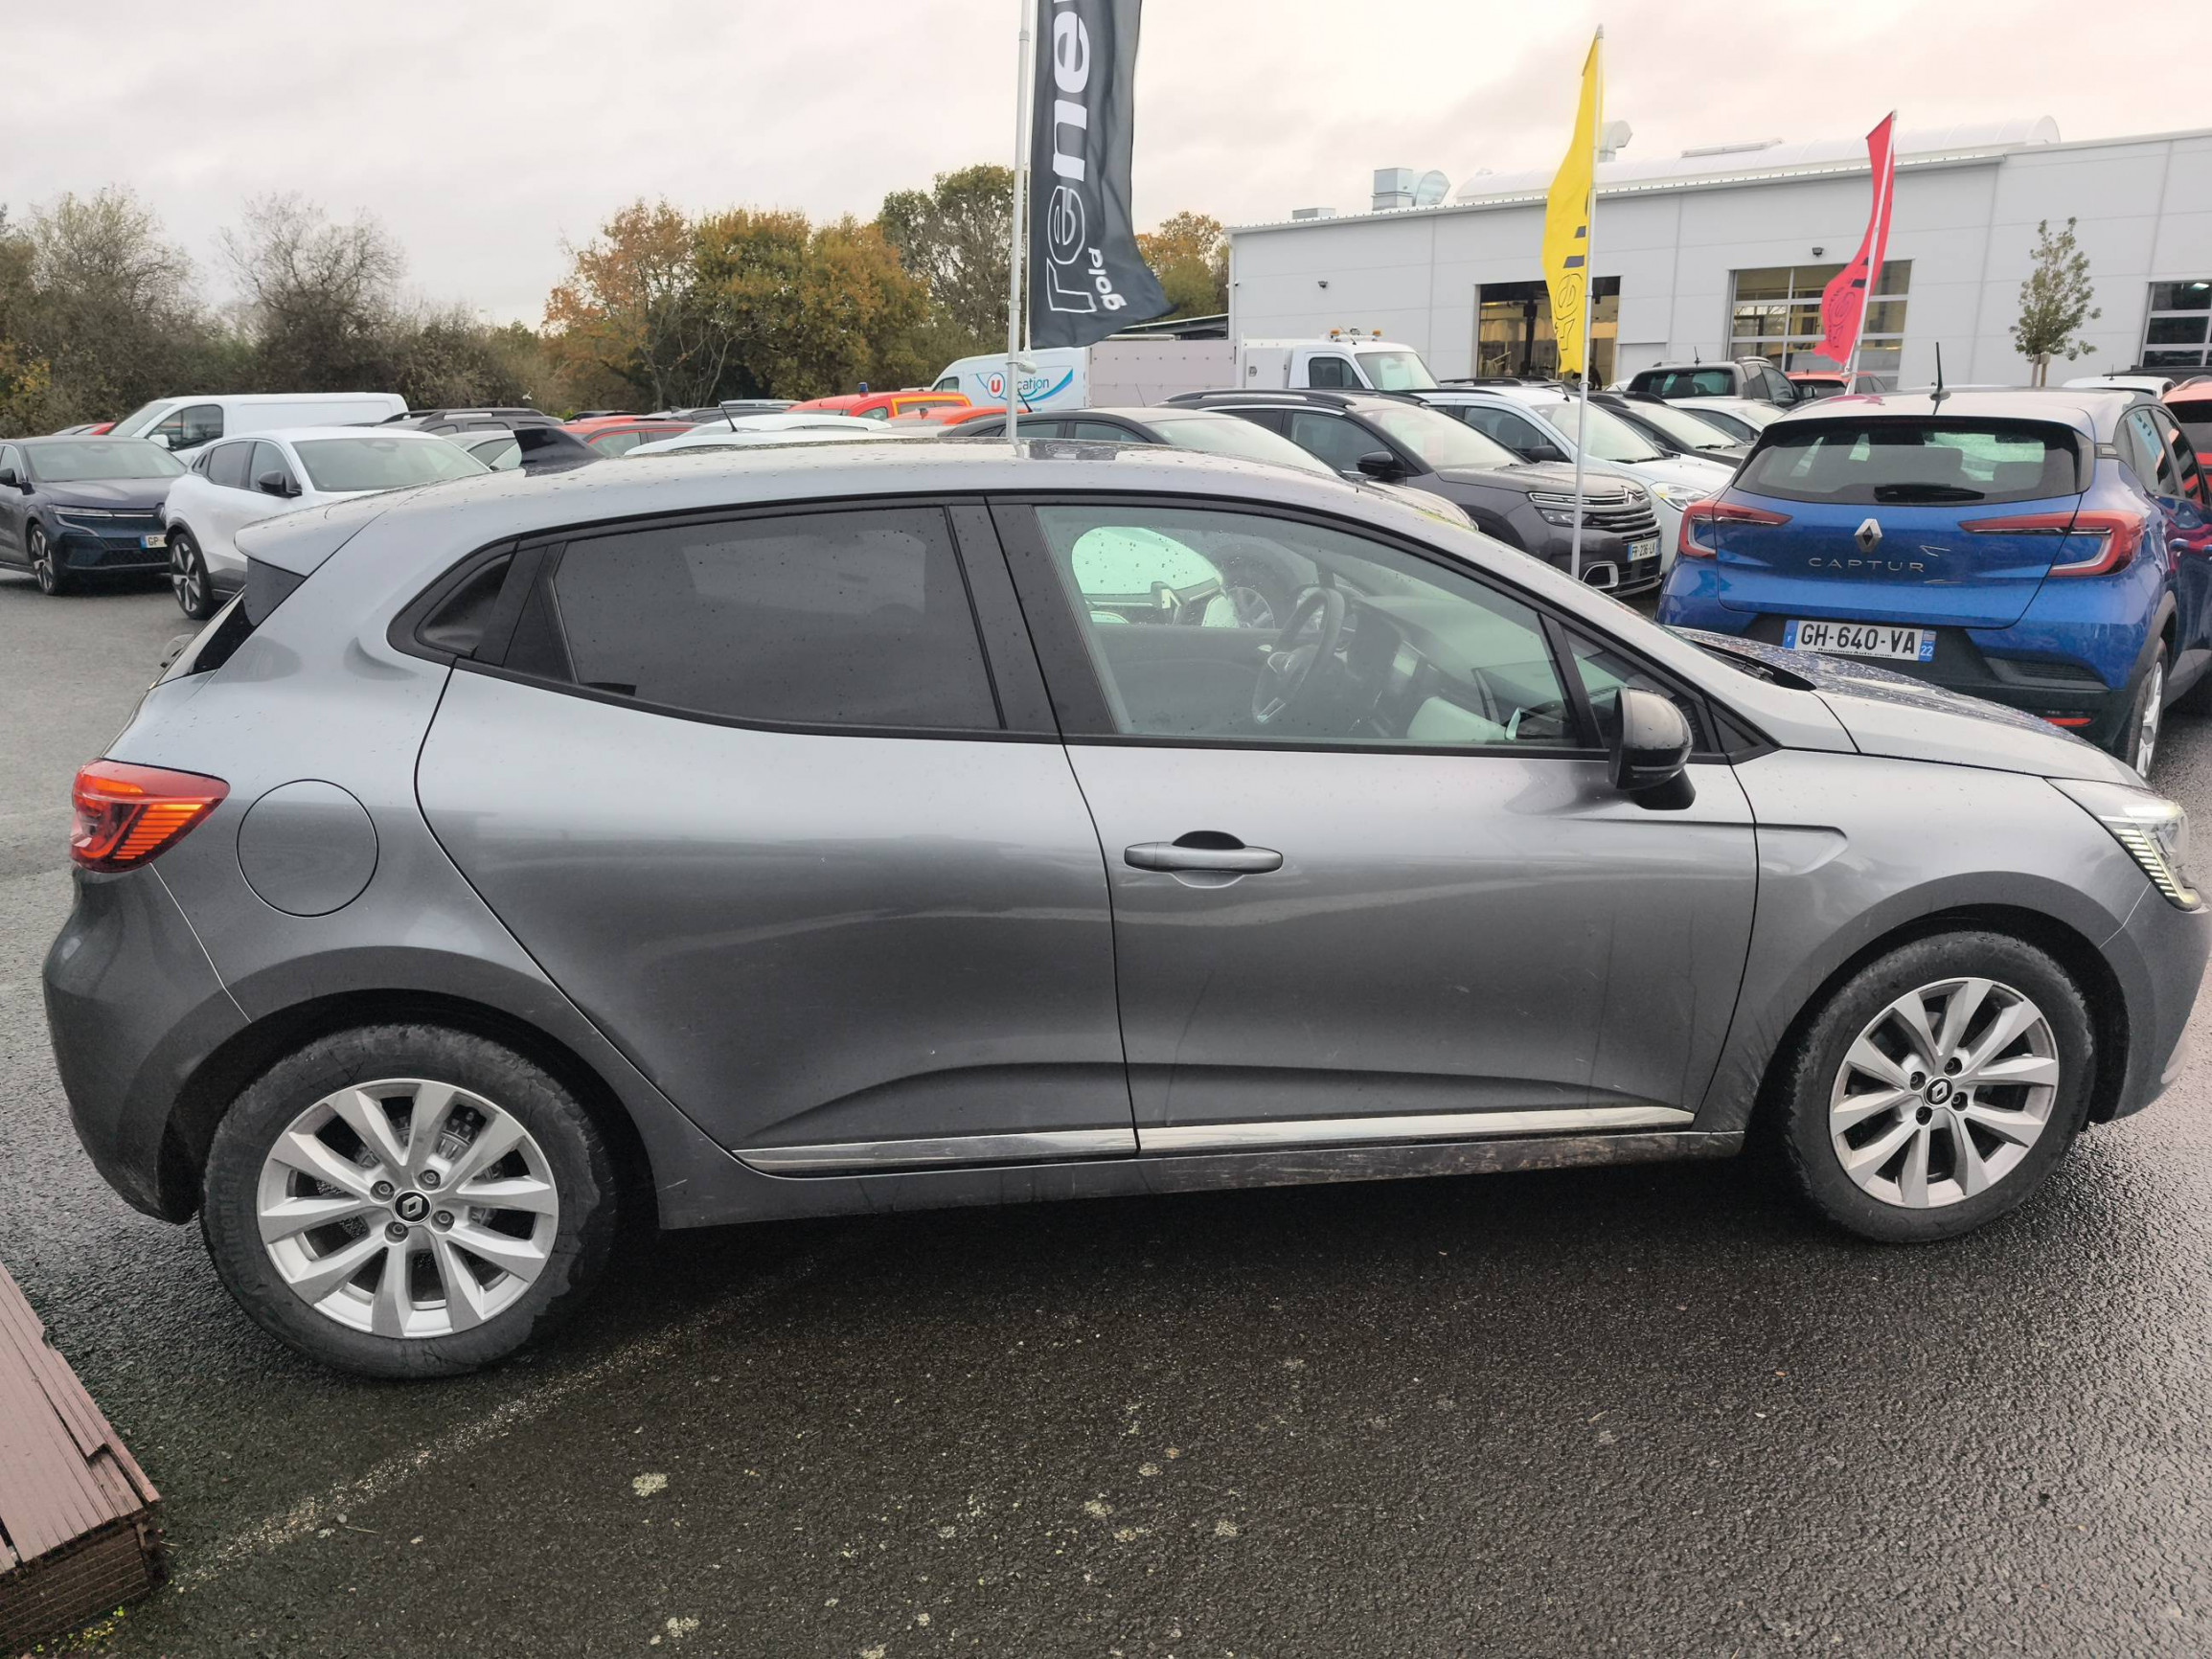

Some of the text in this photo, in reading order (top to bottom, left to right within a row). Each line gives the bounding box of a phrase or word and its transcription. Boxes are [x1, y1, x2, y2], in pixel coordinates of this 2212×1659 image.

[1046, 0, 1098, 313] rene
[1088, 246, 1128, 311] gold
[1808, 557, 1925, 573] CAPTUR
[1801, 624, 1915, 654] GH-640-VA
[1920, 645, 1934, 657] 22
